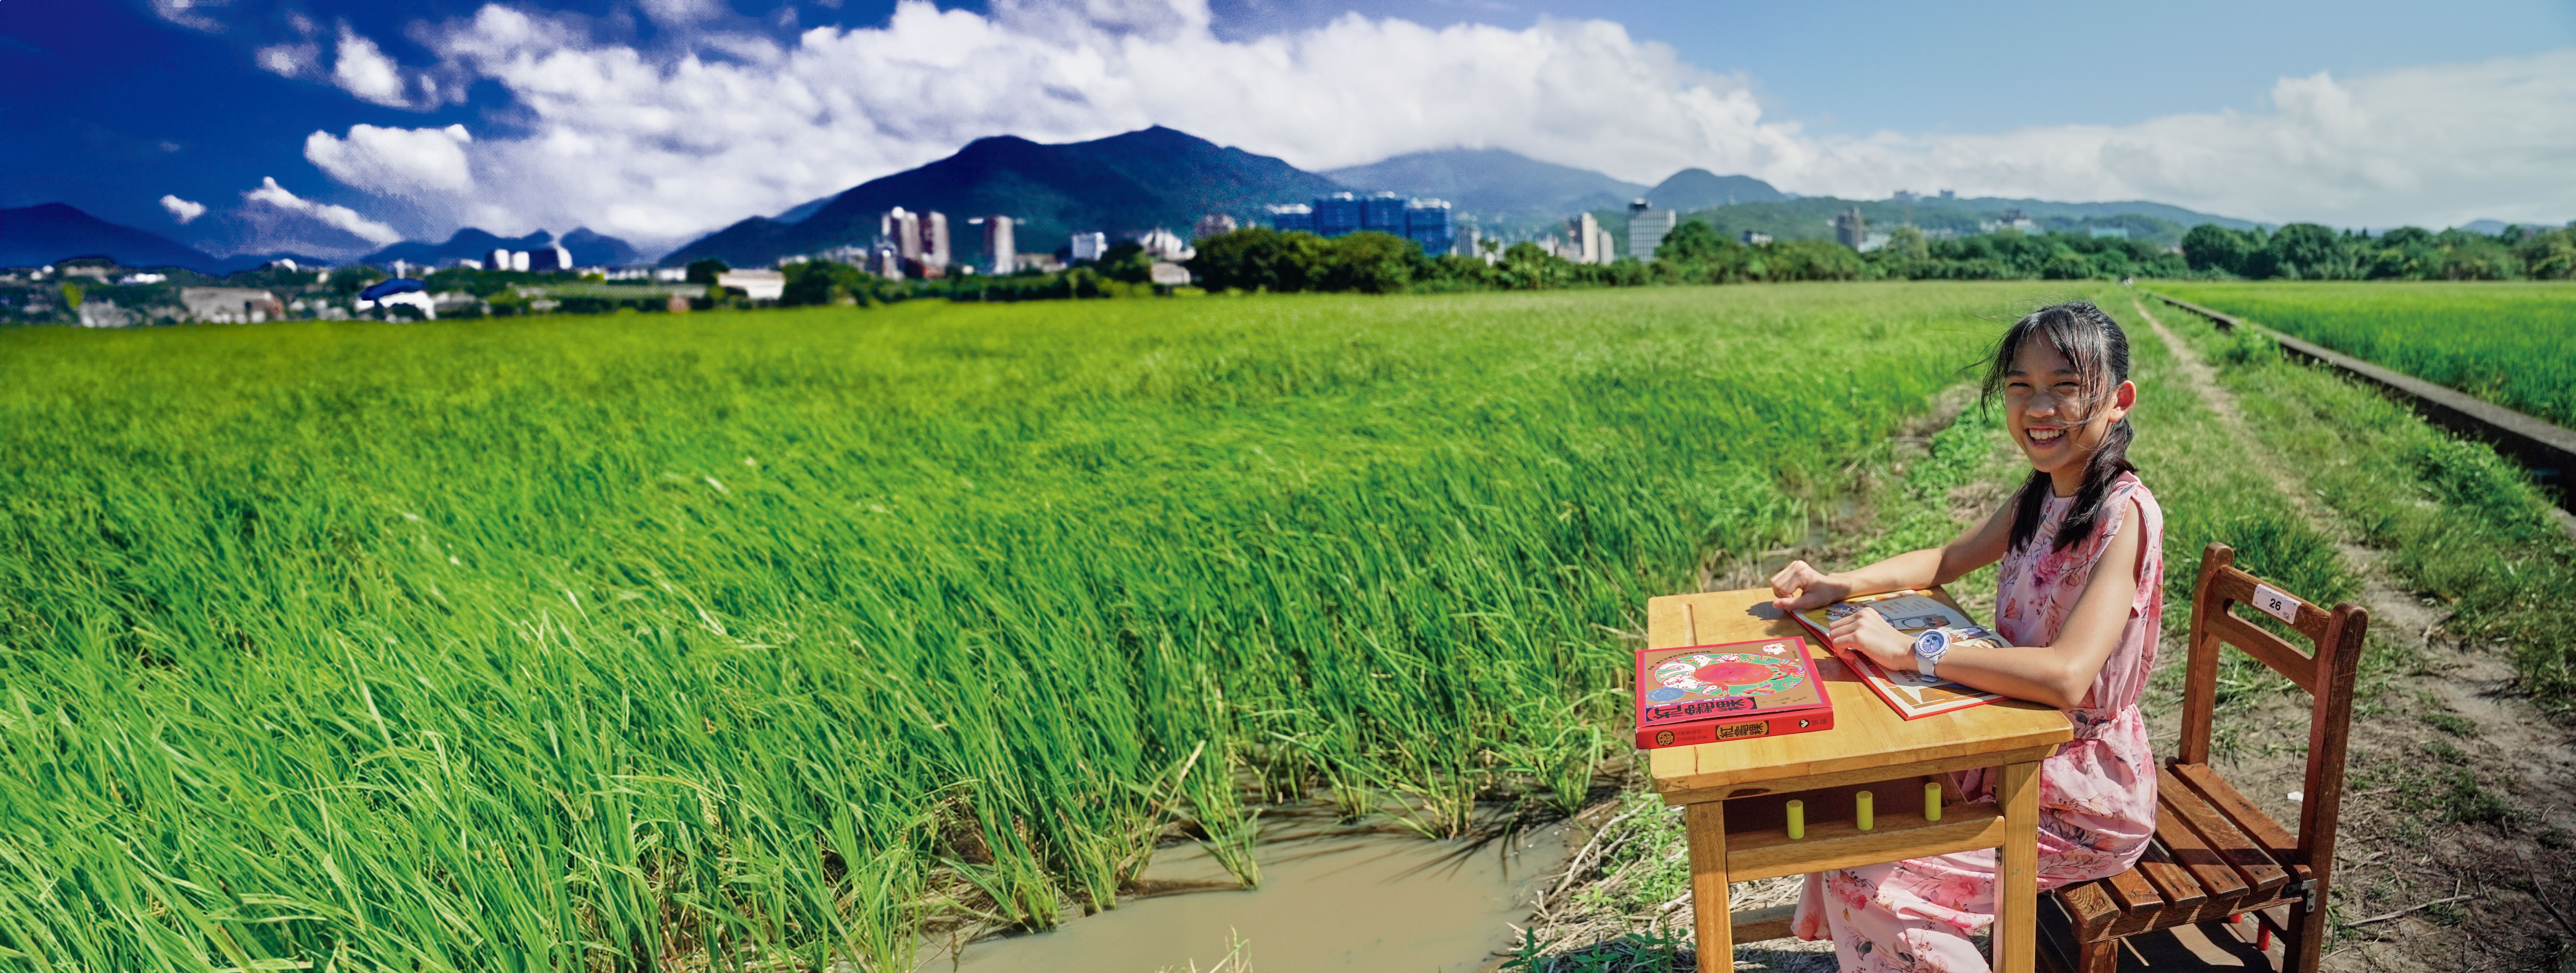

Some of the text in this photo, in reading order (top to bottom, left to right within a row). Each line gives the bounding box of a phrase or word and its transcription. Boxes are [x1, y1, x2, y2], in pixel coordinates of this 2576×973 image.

[2269, 599, 2281, 611] 26
[1653, 698, 1747, 719] 紅龜粿
[1719, 723, 1763, 738] 紅龜粿
